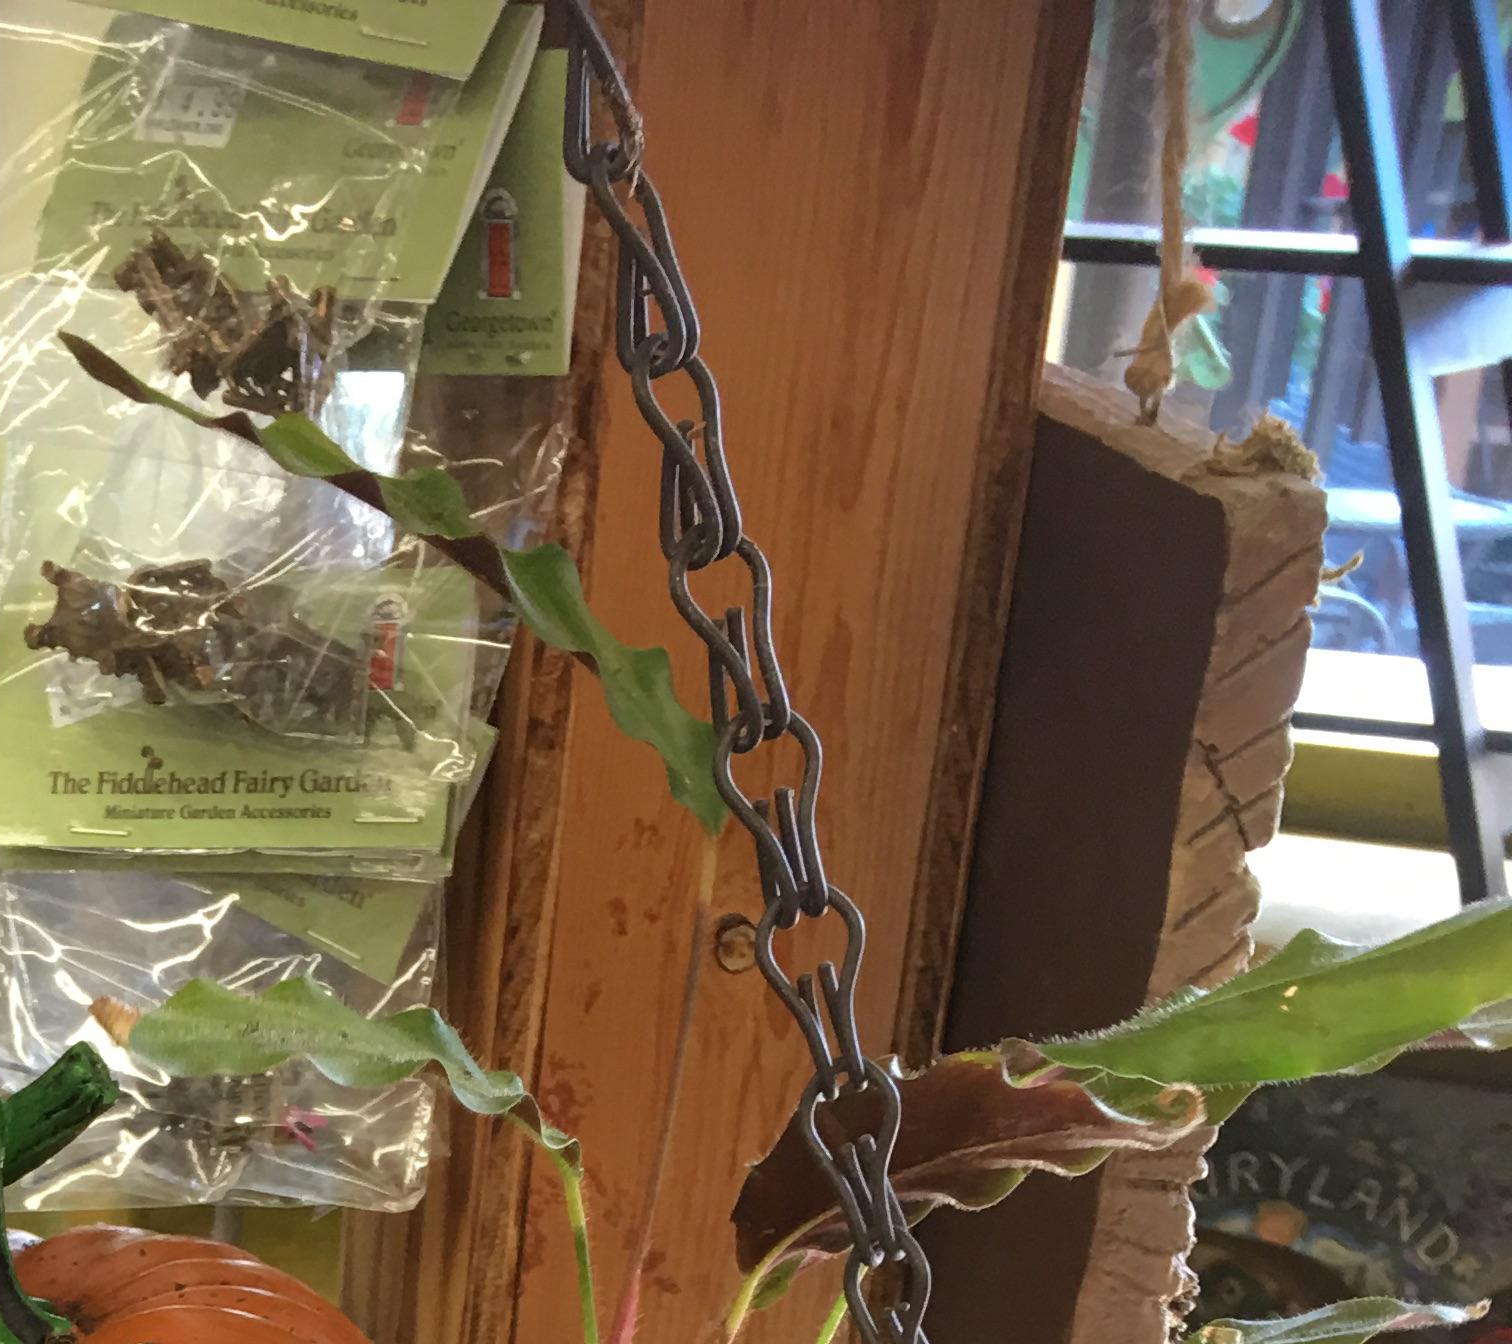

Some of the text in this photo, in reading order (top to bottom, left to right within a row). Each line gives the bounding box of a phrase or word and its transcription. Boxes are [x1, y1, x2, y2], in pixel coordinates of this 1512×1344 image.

[49, 761, 392, 799] The Fiddlehead Fairy Gard
[104, 804, 332, 820] Miniature Garden Accessories
[1191, 1151, 1460, 1274] IRYLAND
